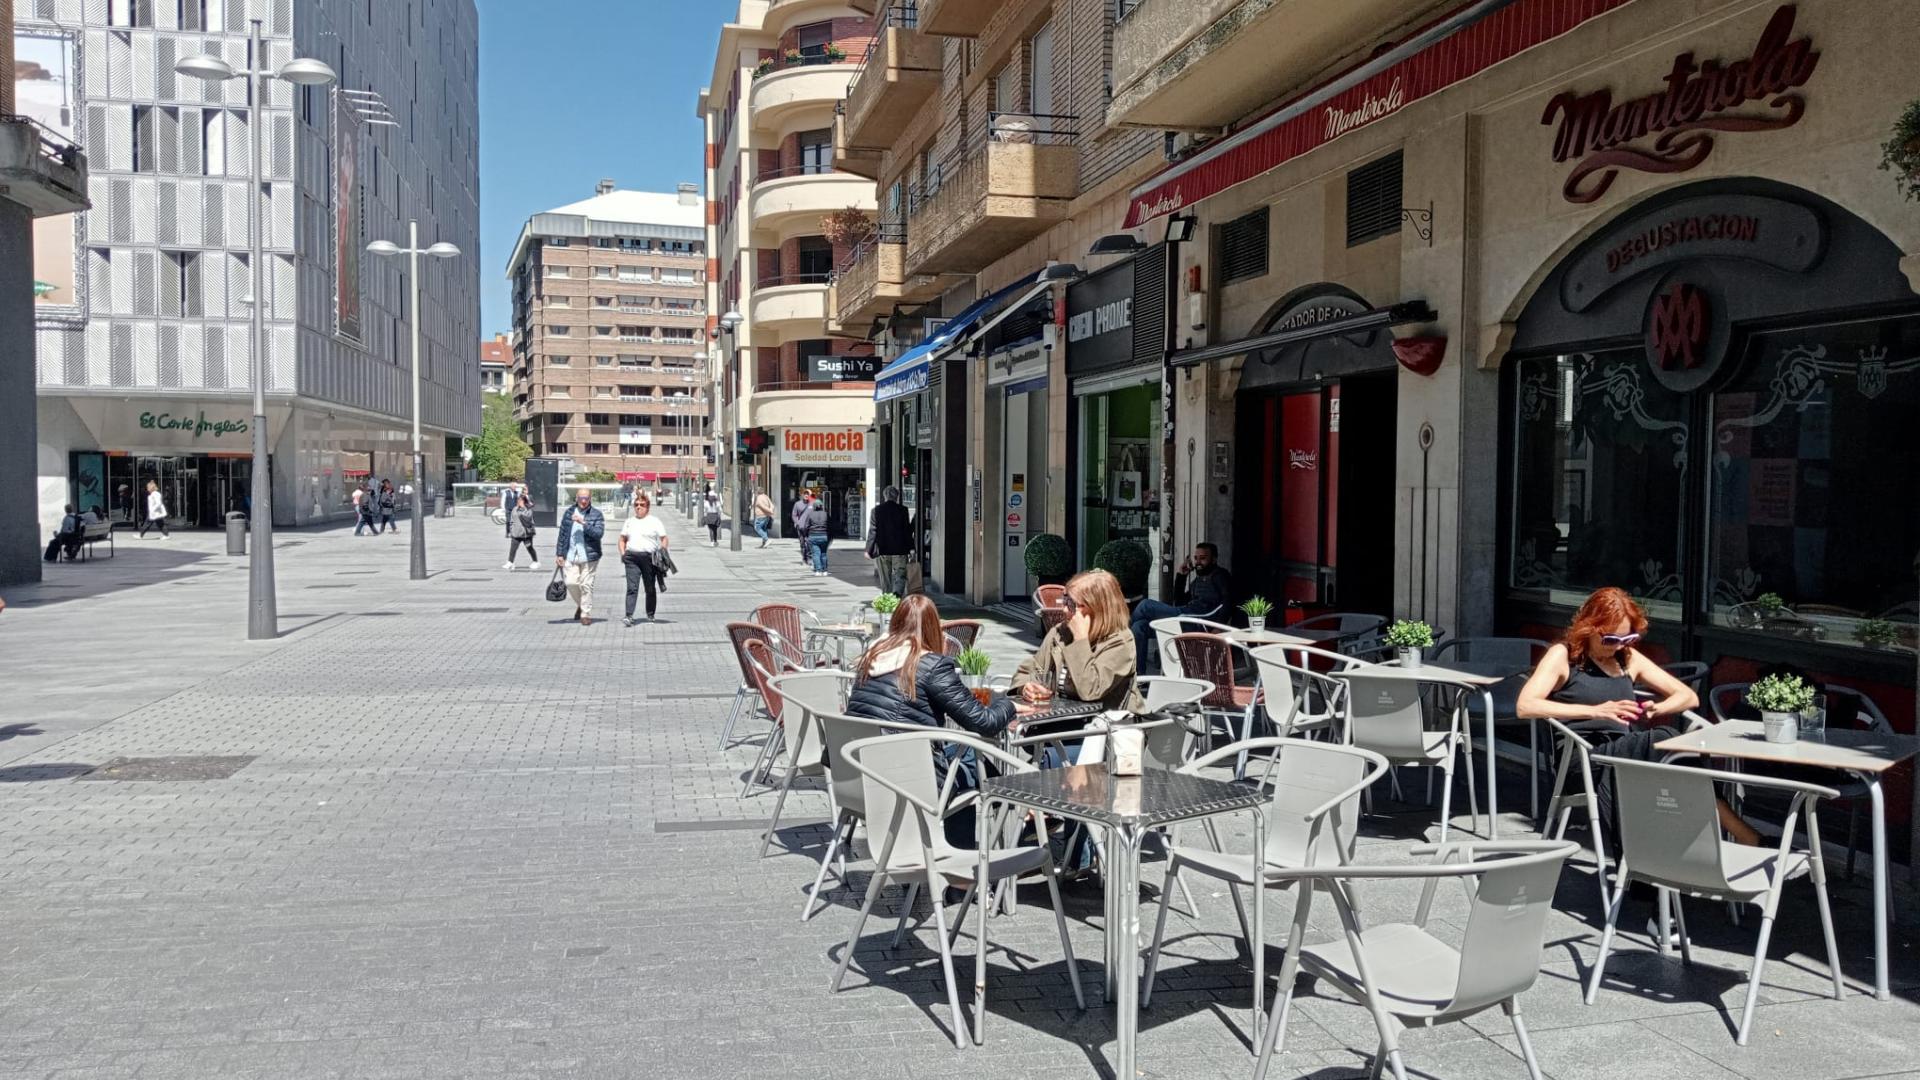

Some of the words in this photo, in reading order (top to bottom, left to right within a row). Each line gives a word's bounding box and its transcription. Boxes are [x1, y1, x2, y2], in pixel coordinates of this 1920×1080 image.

[1540, 3, 1822, 165] Manterola
[1322, 76, 1404, 140] Manterola
[1606, 214, 1759, 273] DEGUSTACION
[1096, 298, 1133, 335] PHONE
[1318, 307, 1330, 321] DE
[817, 360, 854, 371] Sushi
[857, 361, 873, 371] Ya
[140, 412, 155, 428] El
[157, 413, 193, 430] Corte
[195, 411, 248, 437] Inglés
[785, 428, 864, 451] farmacia
[795, 453, 827, 462] Soledad
[829, 453, 852, 462] Lorca
